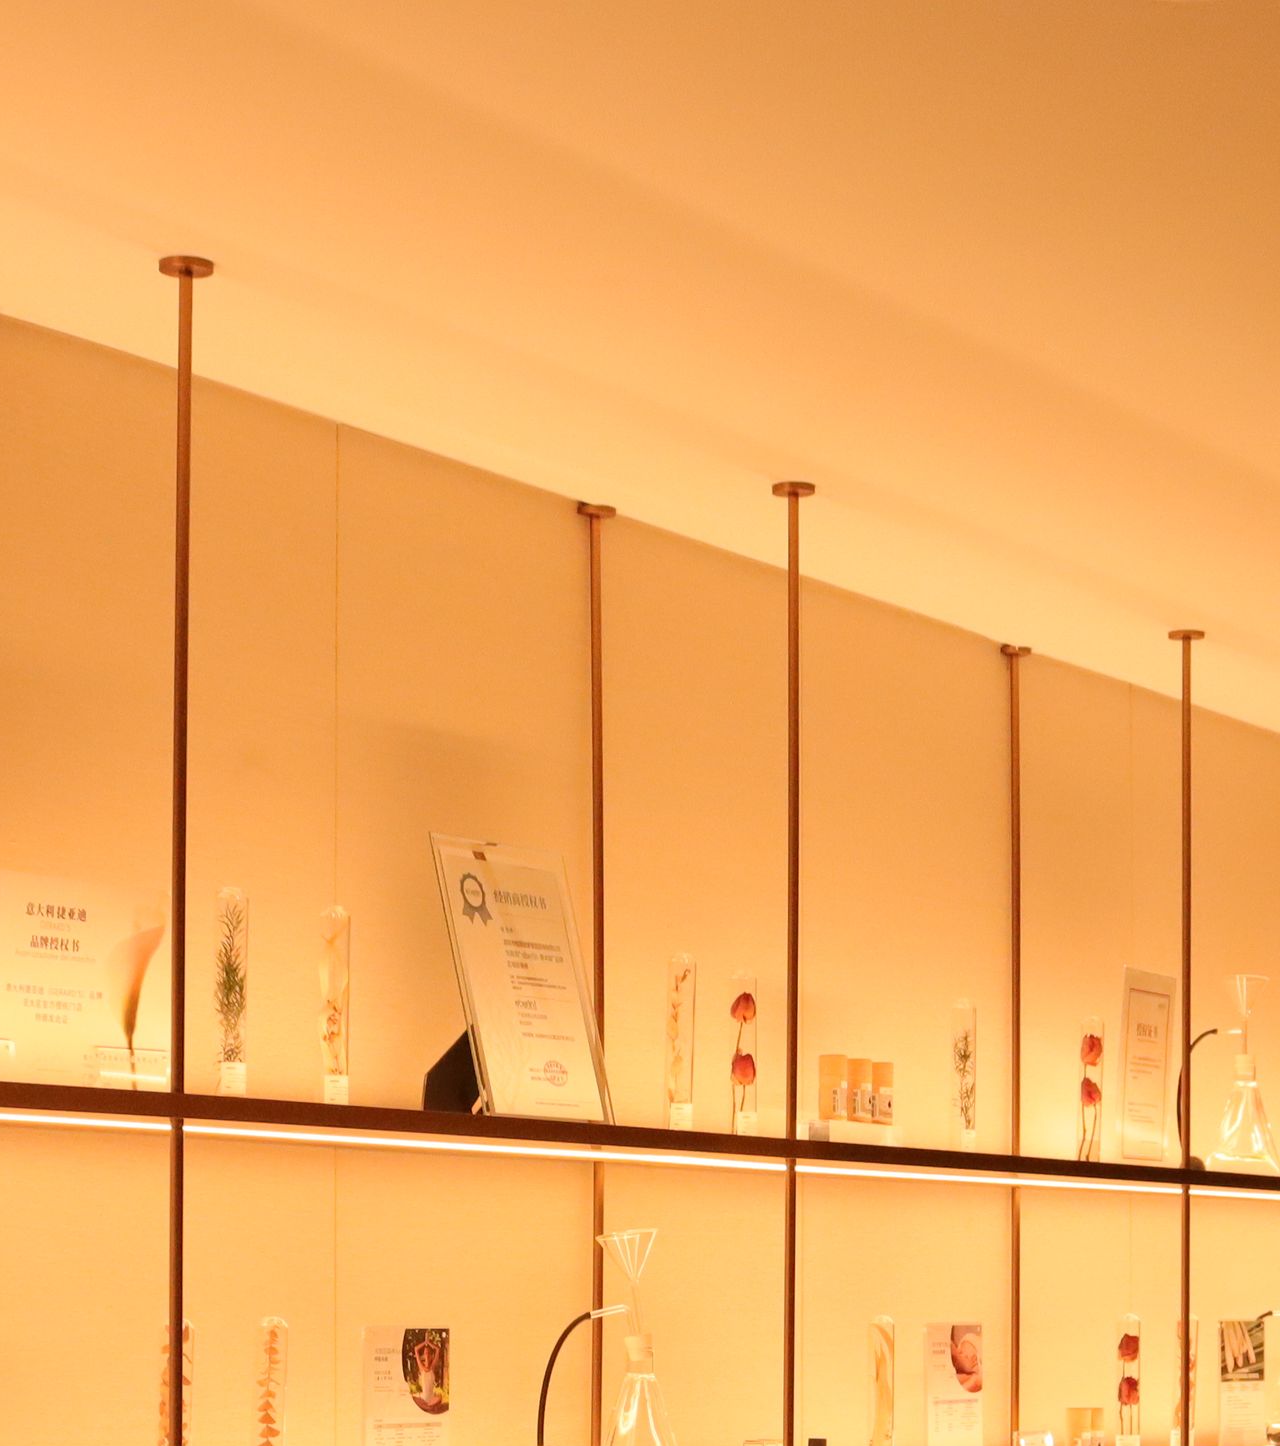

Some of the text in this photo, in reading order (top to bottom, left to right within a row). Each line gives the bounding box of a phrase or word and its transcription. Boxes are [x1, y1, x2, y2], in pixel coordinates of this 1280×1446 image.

[29, 934, 81, 954] 品牌授权书
